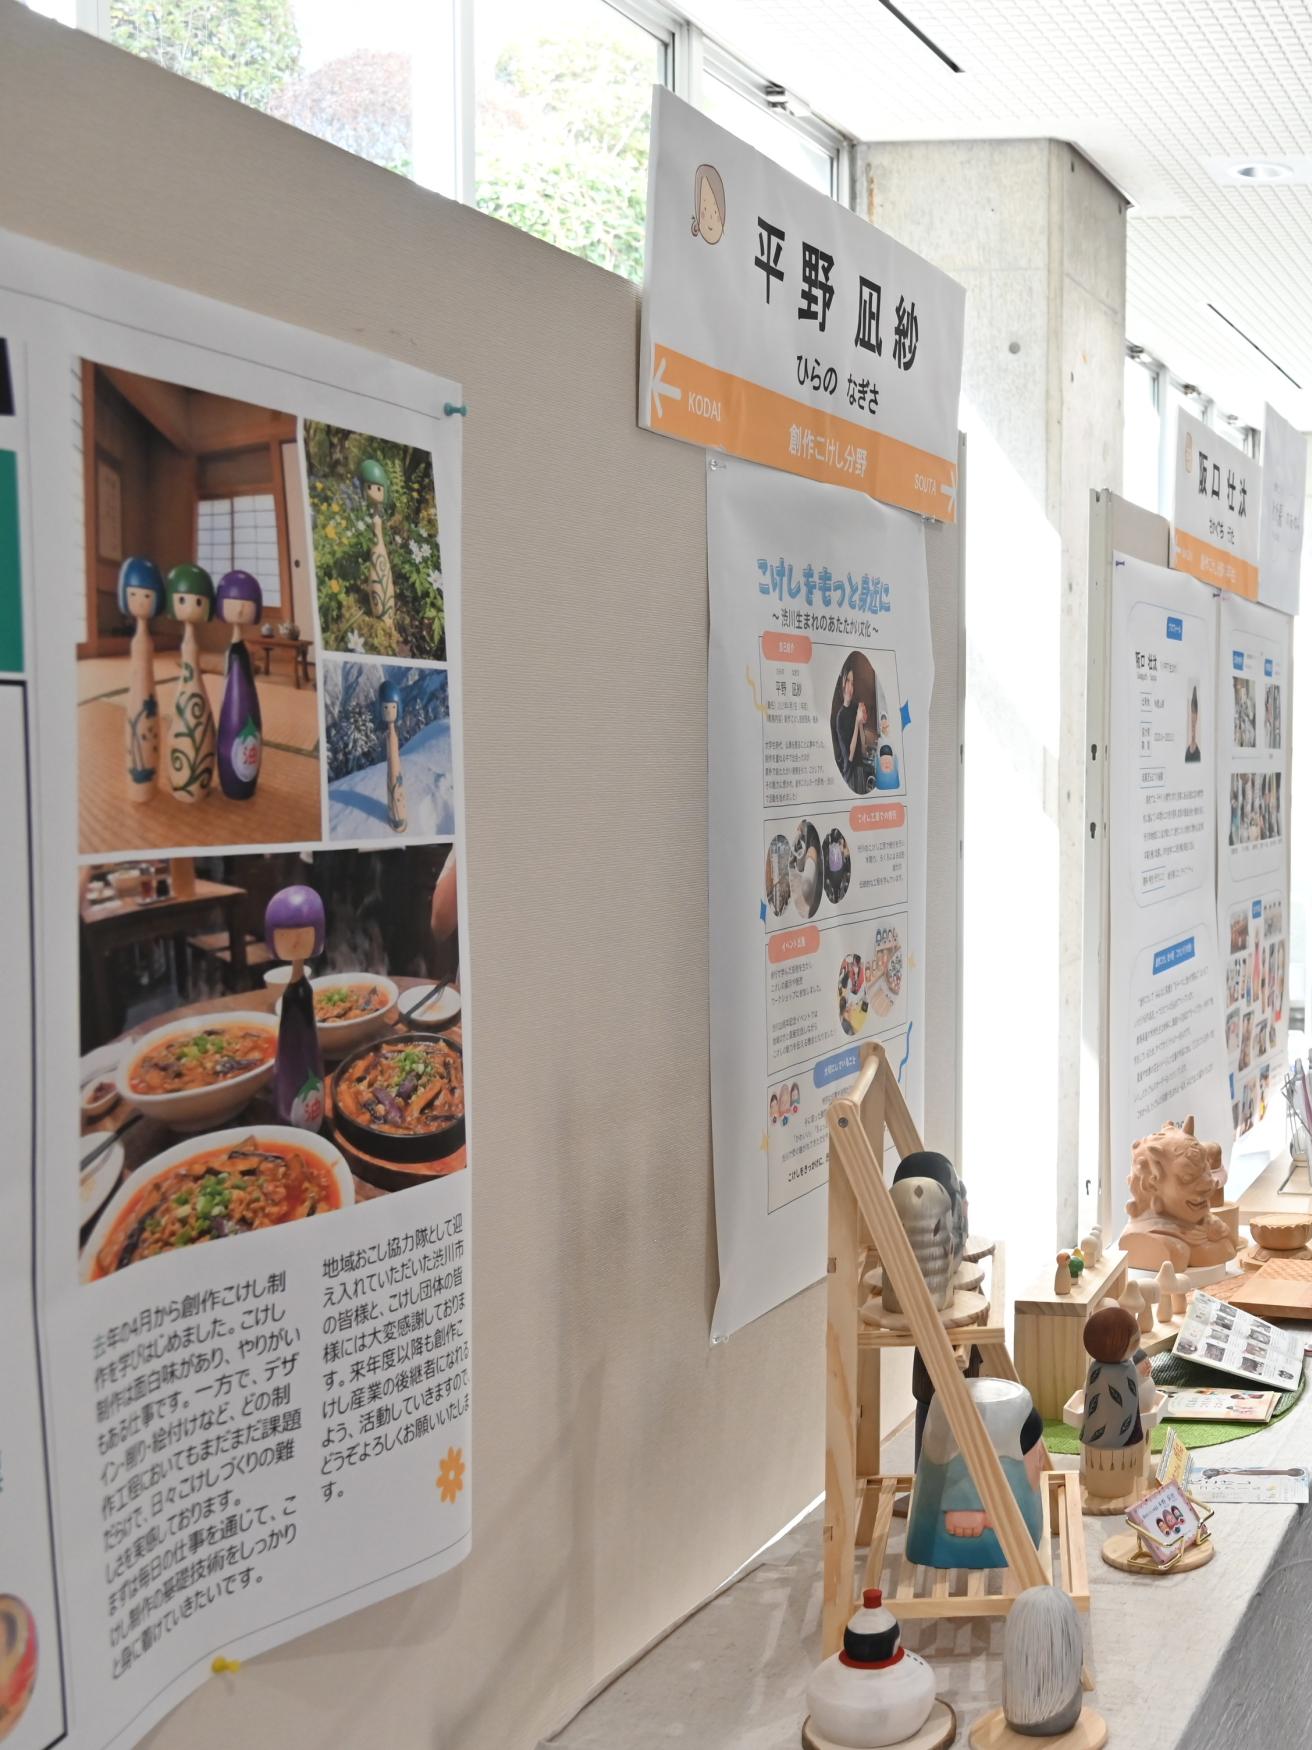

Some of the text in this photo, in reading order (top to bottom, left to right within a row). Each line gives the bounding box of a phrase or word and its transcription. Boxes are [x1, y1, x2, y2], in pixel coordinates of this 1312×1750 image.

[754, 216, 919, 371] 平野 凪紗
[688, 391, 722, 421] KODAI
[796, 355, 879, 415] ひらの なぎさ
[788, 425, 868, 478] 創作こけし分野
[914, 474, 937, 493] SOUTA
[757, 557, 892, 614] こけしをもっと身近に
[322, 1212, 463, 1279] 地域おこし協力隊として迎
[323, 1239, 464, 1308] え入れていただいた渋川市
[322, 1266, 463, 1334] の皆様と、こけし団体の皆
[322, 1293, 465, 1365] 様には大変感謝しておりま
[322, 1319, 464, 1391] す。来年度以降も創作こ
[322, 1342, 470, 1420] けし産業の後継者になれる
[320, 1398, 469, 1477] どうぞよろしくお願いいたしま
[321, 1480, 345, 1504] す。
